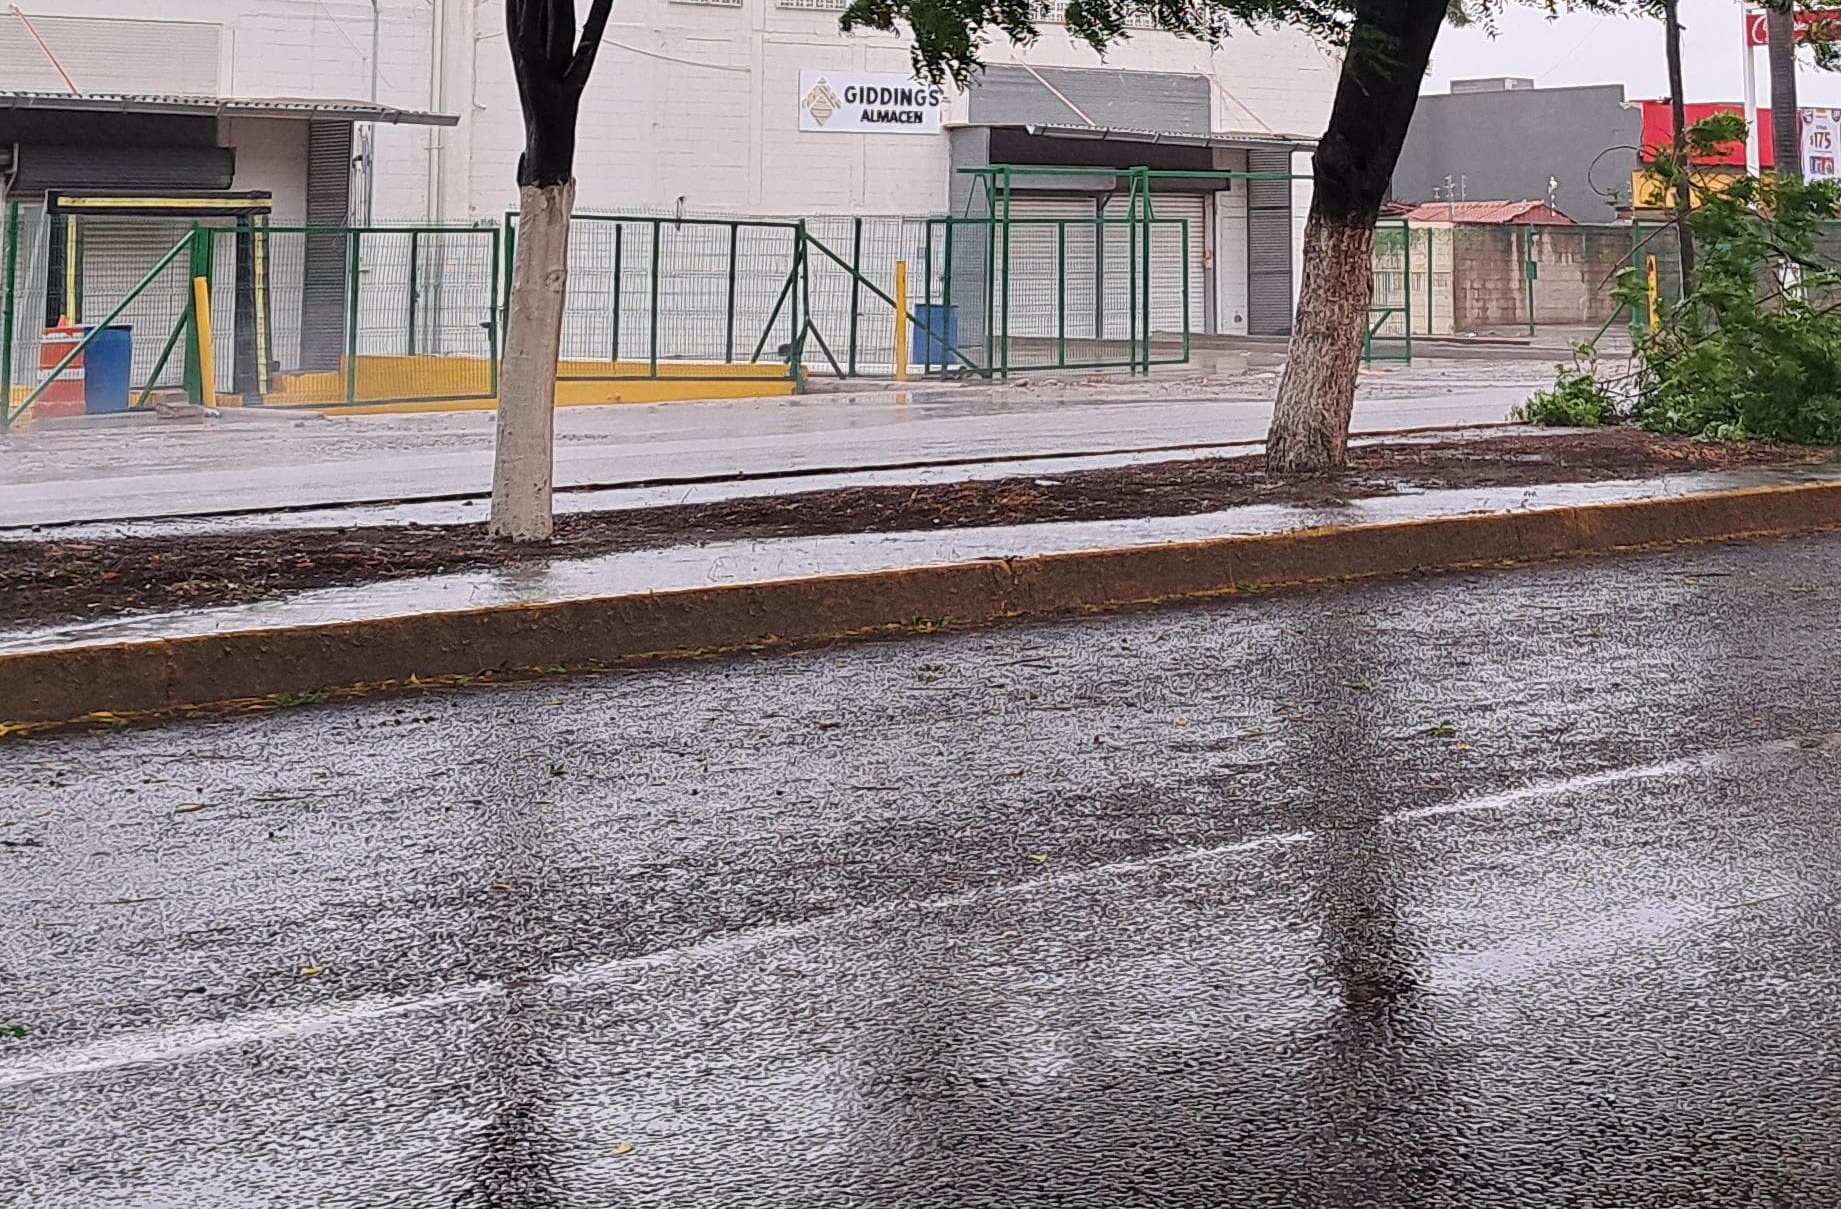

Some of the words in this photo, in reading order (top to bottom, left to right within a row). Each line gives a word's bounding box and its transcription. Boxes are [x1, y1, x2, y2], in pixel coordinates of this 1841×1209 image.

[844, 85, 939, 107] GIDDINGS
[860, 109, 923, 124] ALMACEN
[1809, 131, 1832, 149] $175
